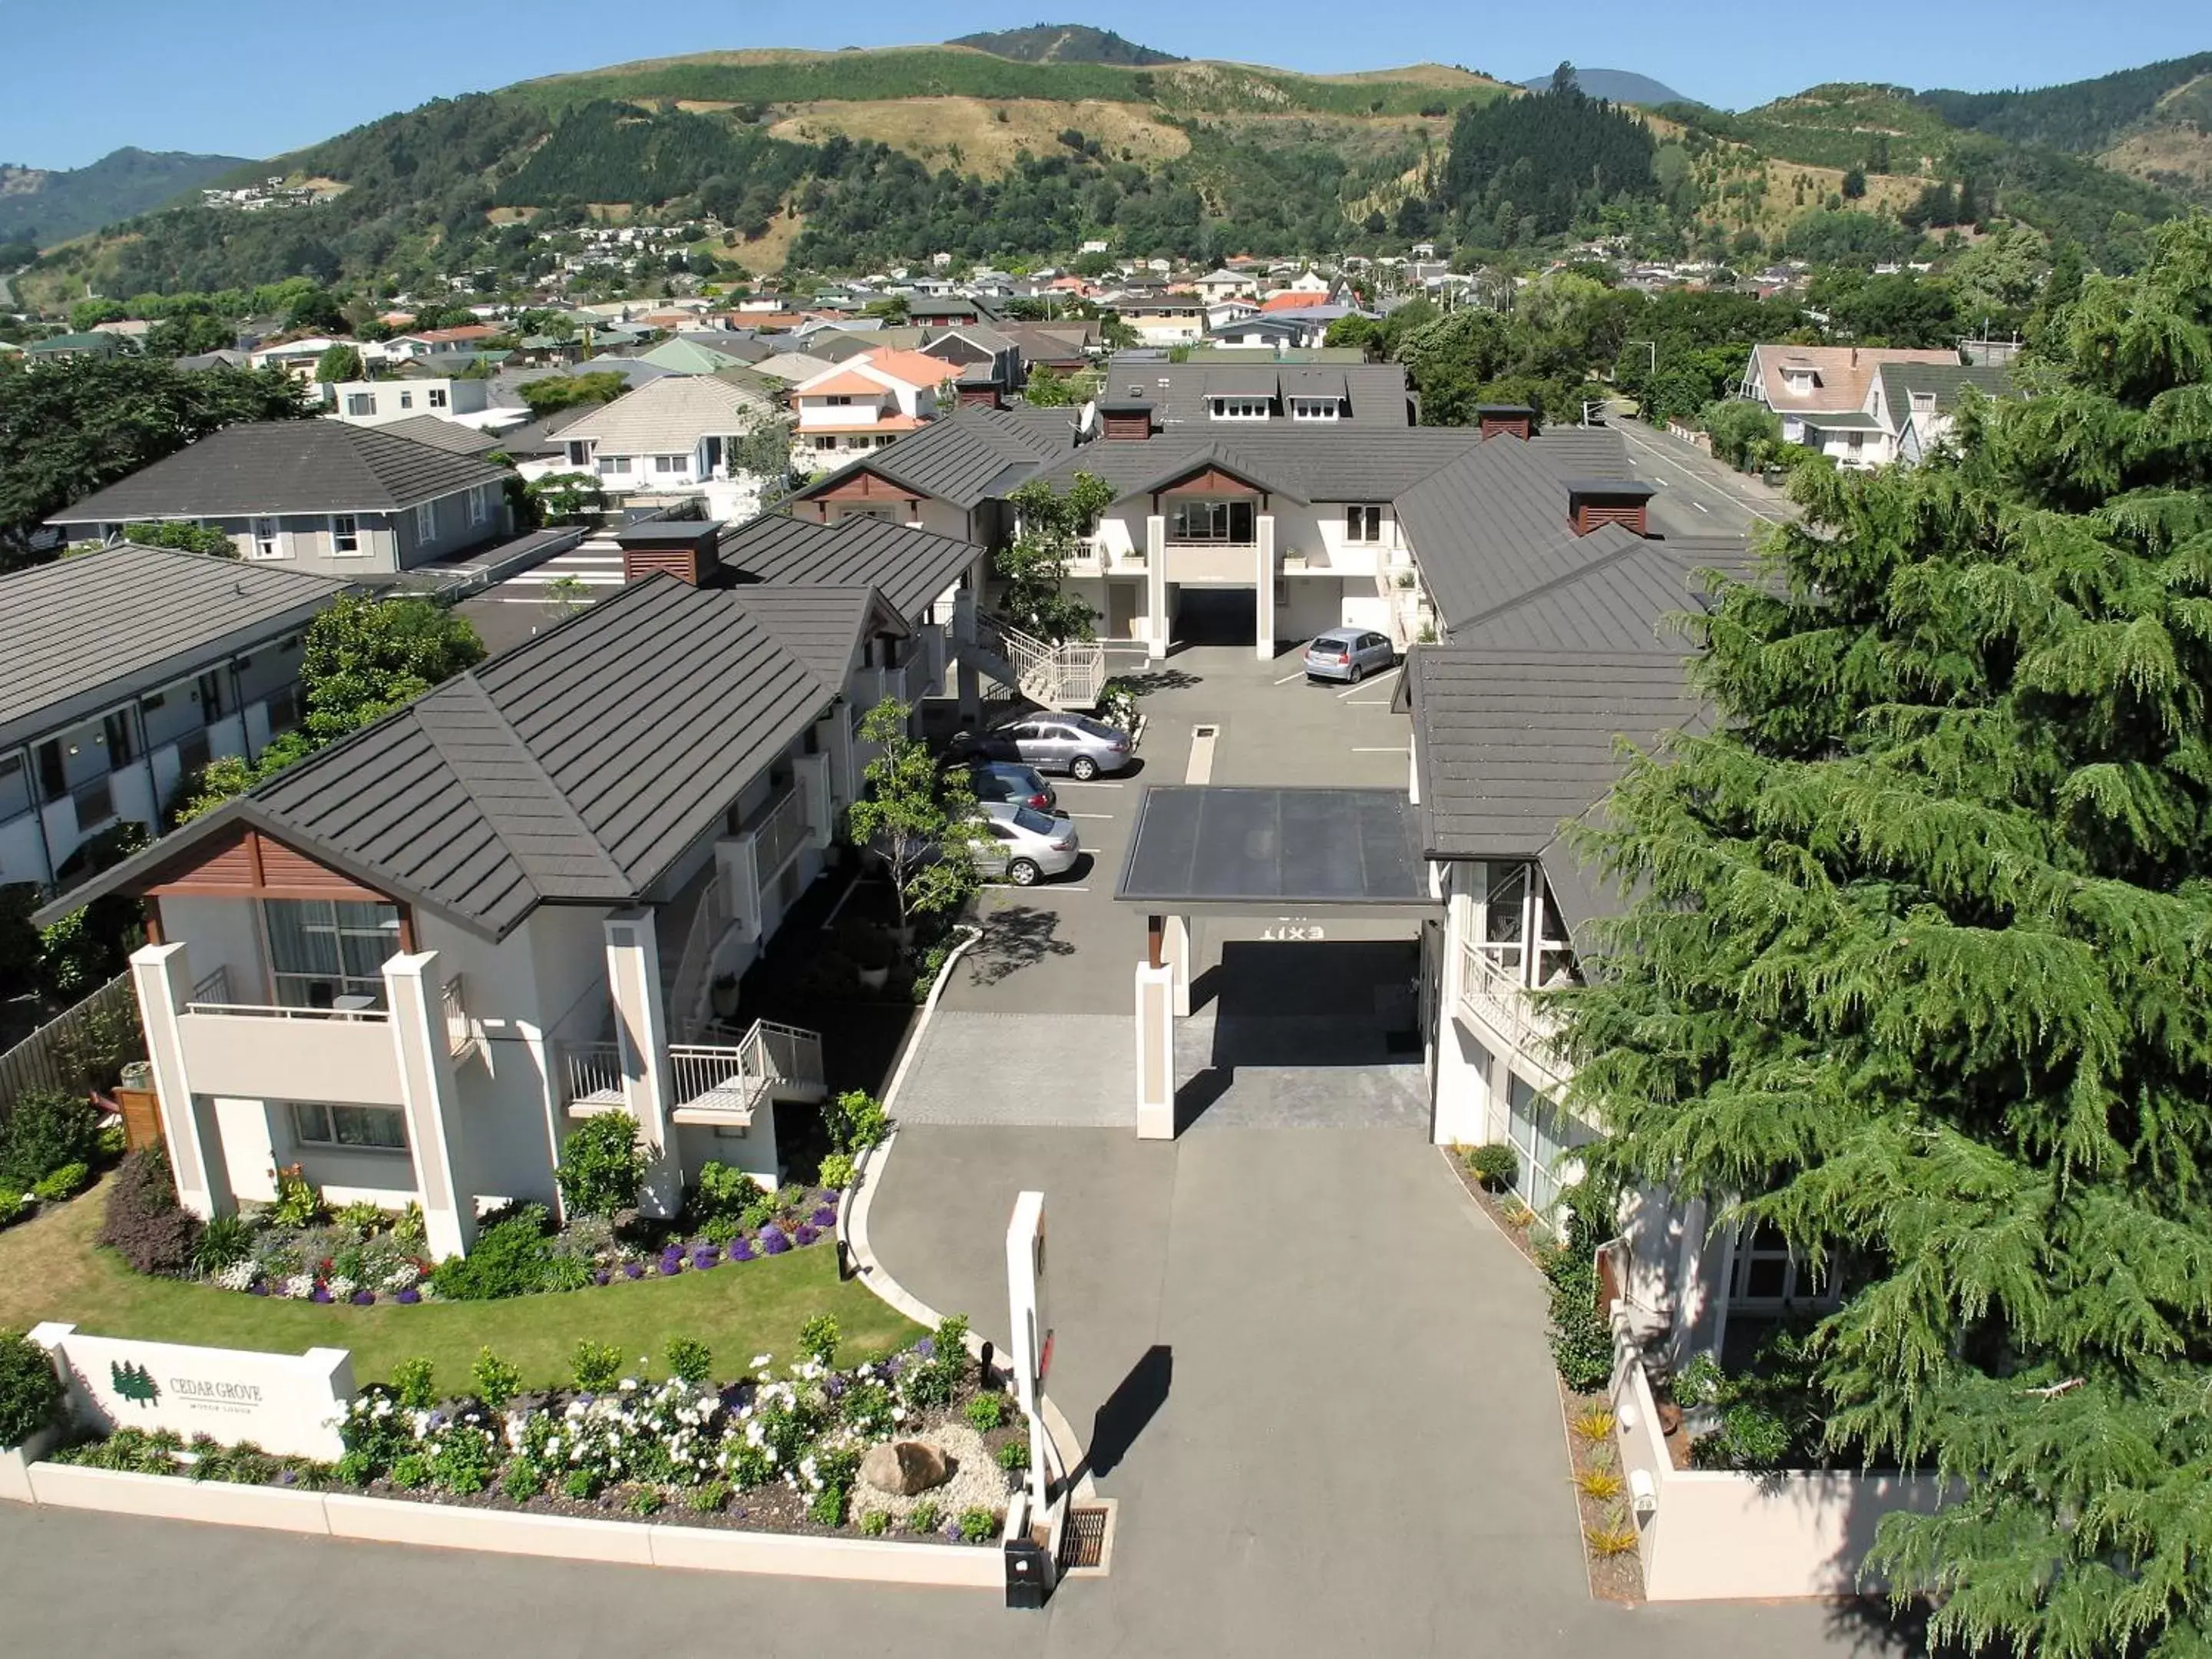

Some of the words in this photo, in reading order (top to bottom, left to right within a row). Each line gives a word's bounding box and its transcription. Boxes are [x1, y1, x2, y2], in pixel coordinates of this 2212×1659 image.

[1258, 926, 1324, 940] EXIT
[170, 1378, 214, 1396] CEDAR
[215, 1381, 263, 1402] GROVE
